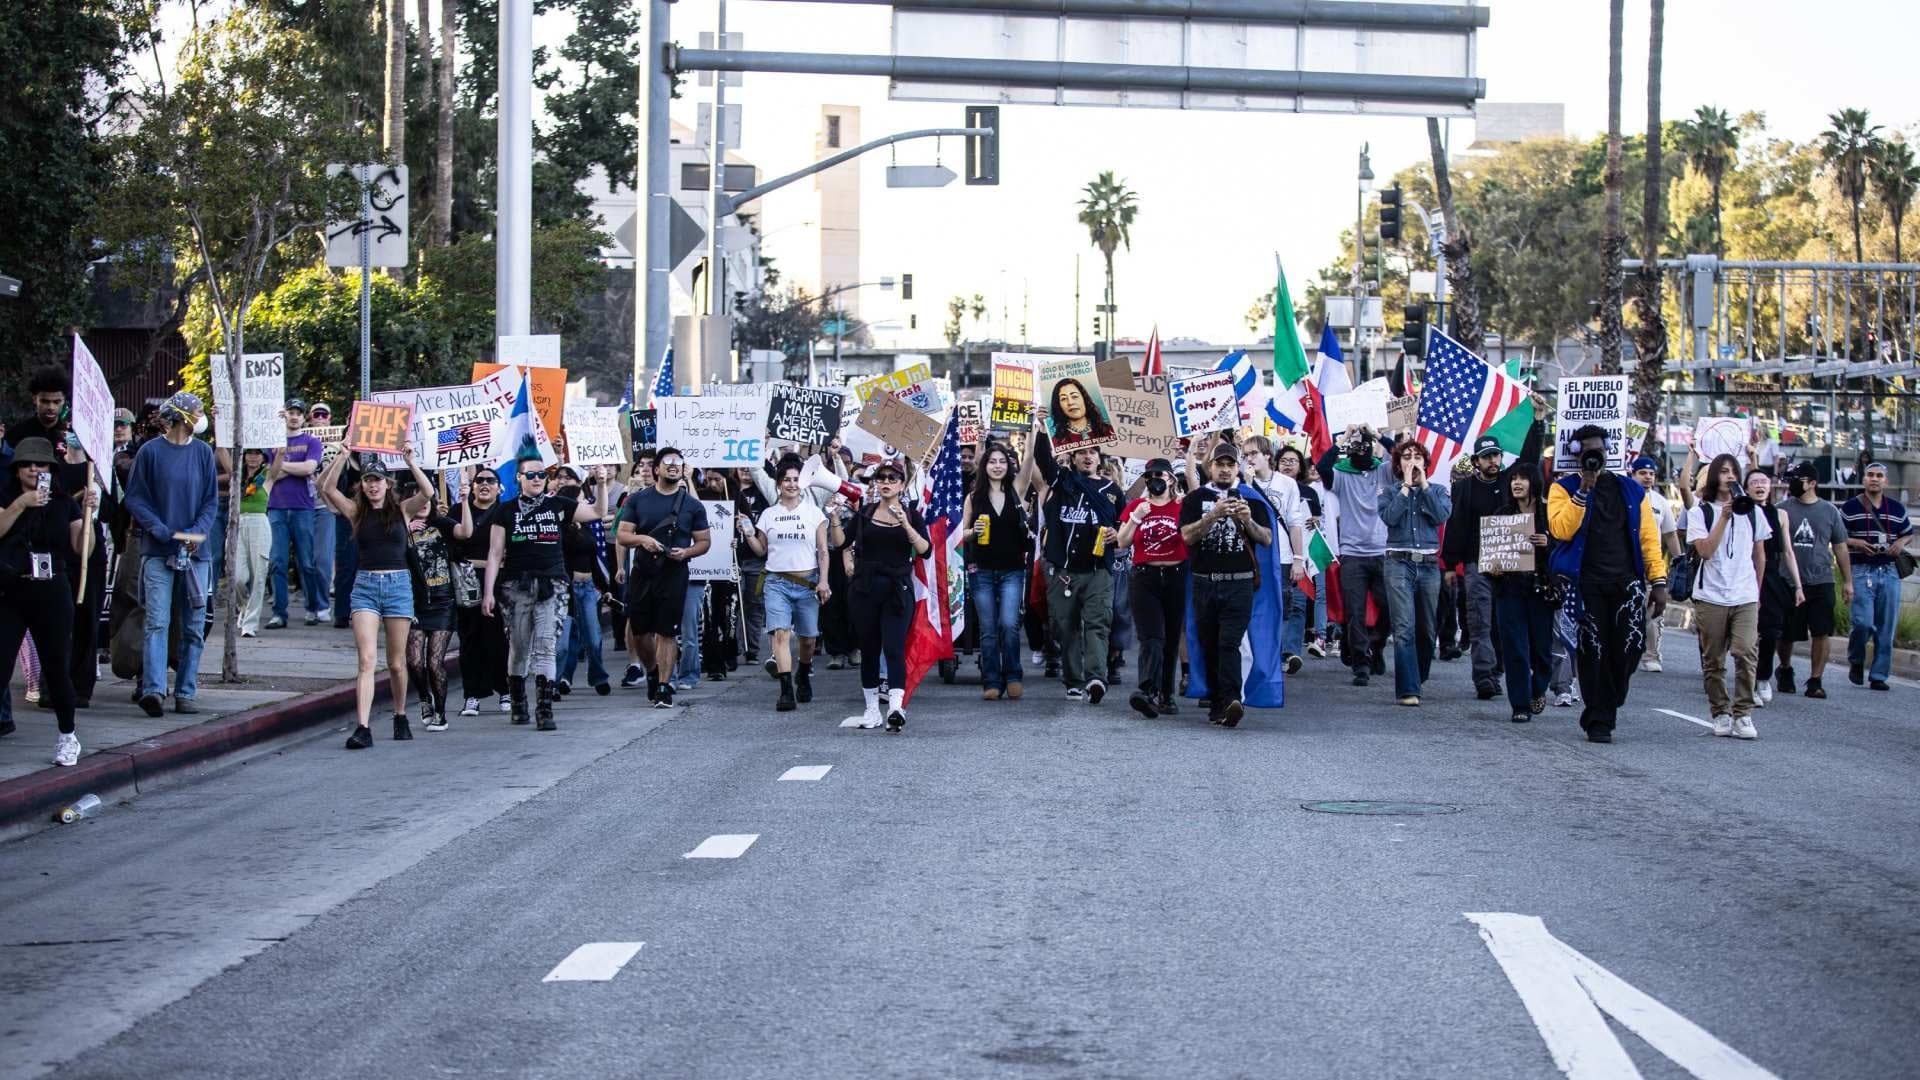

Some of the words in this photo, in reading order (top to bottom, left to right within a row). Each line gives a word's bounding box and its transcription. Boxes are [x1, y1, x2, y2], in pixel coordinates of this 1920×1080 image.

[245, 356, 282, 379] ROOTS
[888, 383, 922, 401] Trash
[1133, 376, 1167, 395] FUC
[1564, 382, 1580, 394] ¡EL
[1583, 380, 1623, 392] PUEBLO
[414, 392, 443, 413] Are
[449, 387, 480, 411] Not
[773, 386, 840, 409] IMMIGRANTS
[1007, 401, 1019, 411] ES
[1174, 397, 1216, 416] Camps
[1568, 392, 1618, 409] UNIDO
[355, 403, 410, 431] FUCK
[427, 416, 446, 431] IS
[447, 410, 479, 426] THIS
[482, 406, 503, 423] UR
[691, 401, 725, 420] Decent
[783, 400, 824, 420] MAKE
[959, 404, 978, 418] CE
[992, 410, 1031, 425] ILEGAL
[1565, 407, 1621, 420] DEFENDERÁ
[630, 412, 651, 429] This
[772, 412, 827, 431] AMERICA
[1117, 413, 1147, 428] THE
[1179, 415, 1210, 436] Exist
[356, 426, 400, 450] ICE
[776, 424, 830, 446] GREAT
[576, 443, 620, 461] FASCISM
[722, 438, 761, 461] ICE
[1055, 441, 1079, 453] DEFEND
[1080, 438, 1093, 448] OUR
[437, 442, 490, 468] FLAG?
[513, 524, 536, 534] Anti
[1480, 516, 1488, 528] IT
[777, 532, 806, 541] MIGRA
[1480, 527, 1499, 537] HAVE
[1500, 527, 1511, 535] TO
[1481, 535, 1512, 546] HAPPEN
[1481, 546, 1497, 556] YOU
[1521, 541, 1533, 551] TO
[1481, 562, 1493, 571] TO
